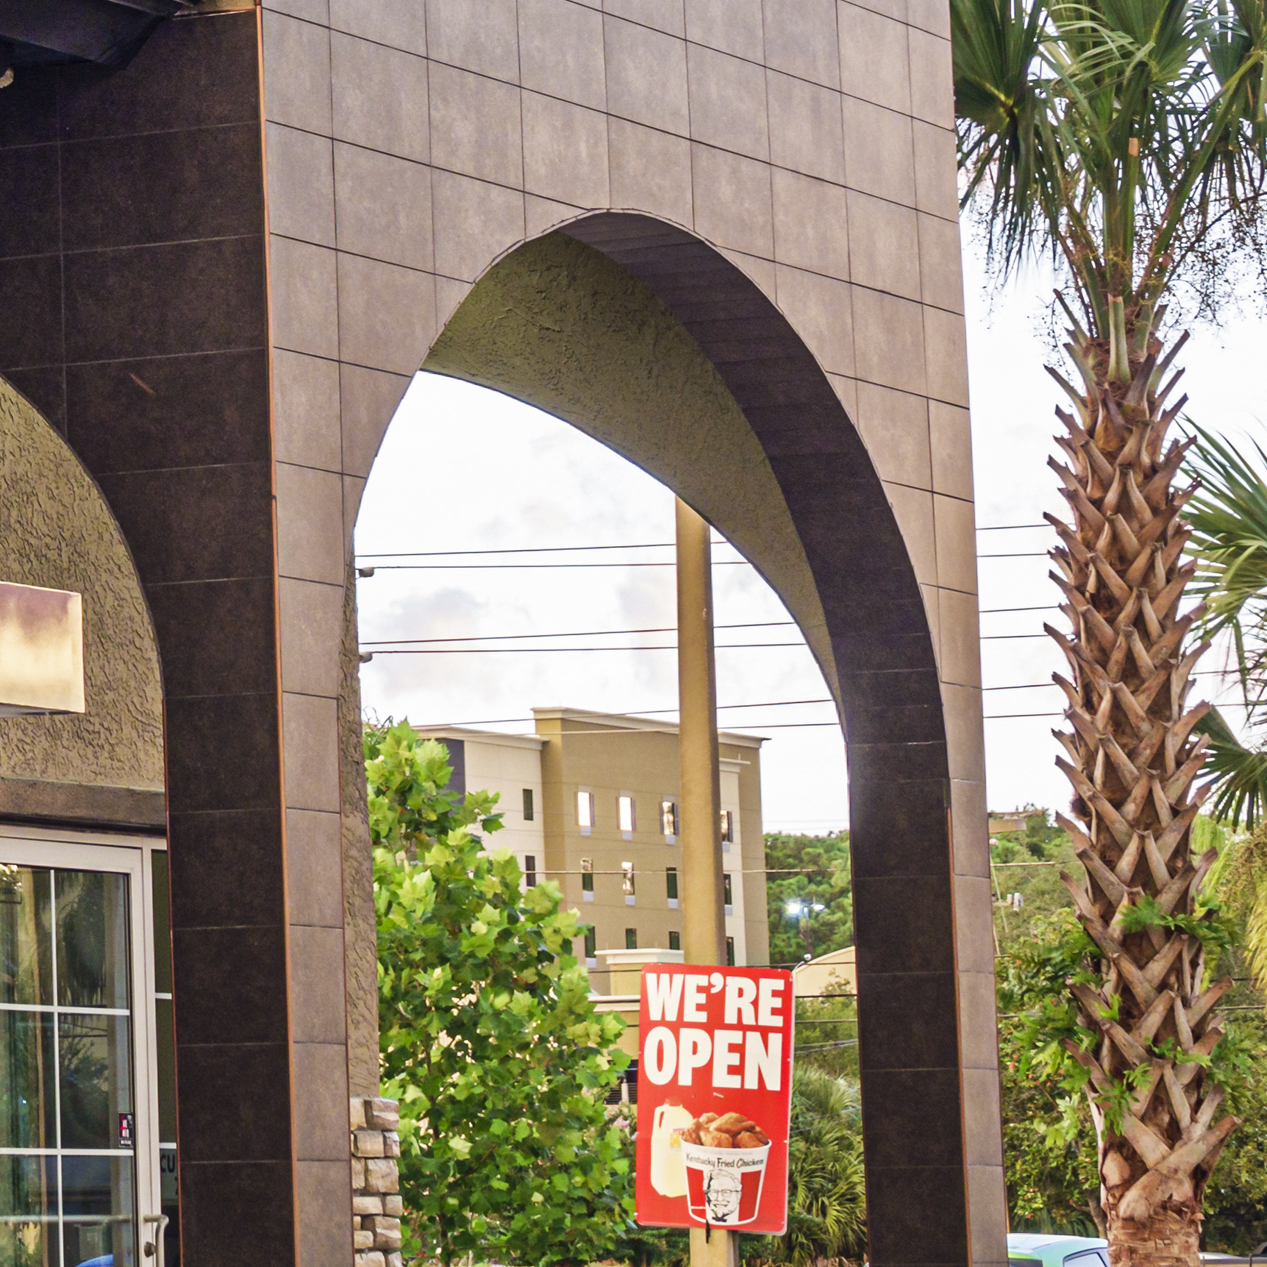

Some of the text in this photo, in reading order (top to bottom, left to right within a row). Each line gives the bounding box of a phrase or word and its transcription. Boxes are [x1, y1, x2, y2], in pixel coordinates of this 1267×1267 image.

[645, 972, 784, 1026] WE'RE
[644, 1026, 782, 1091] OPEN
[685, 1152, 764, 1168] Kentucky Fried Chicken
